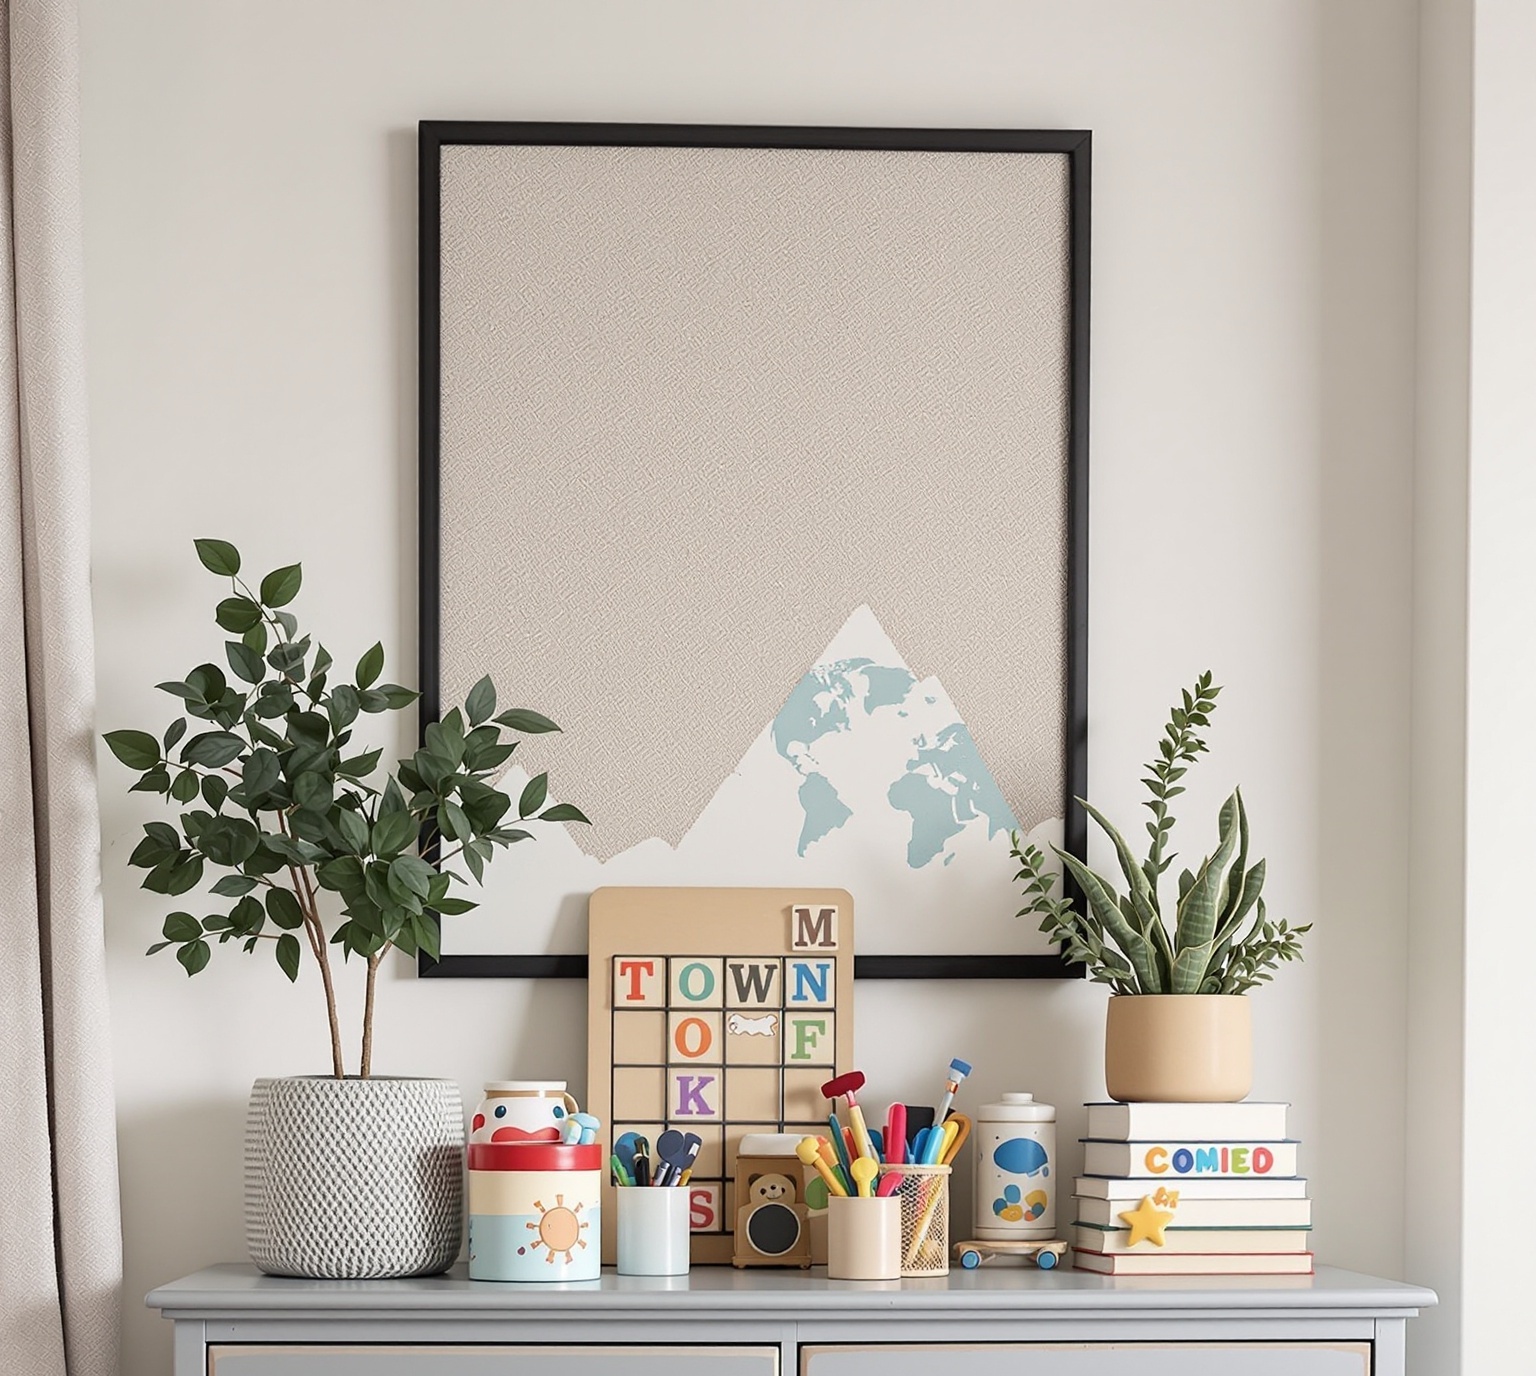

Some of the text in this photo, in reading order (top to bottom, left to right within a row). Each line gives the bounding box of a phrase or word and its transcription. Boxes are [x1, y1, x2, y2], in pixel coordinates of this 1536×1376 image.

[794, 908, 836, 947] M
[620, 961, 830, 1003] TOWN
[674, 1017, 826, 1059] O F
[675, 1075, 715, 1115] K
[1145, 1147, 1274, 1174] COMIED
[689, 1190, 713, 1229] S
